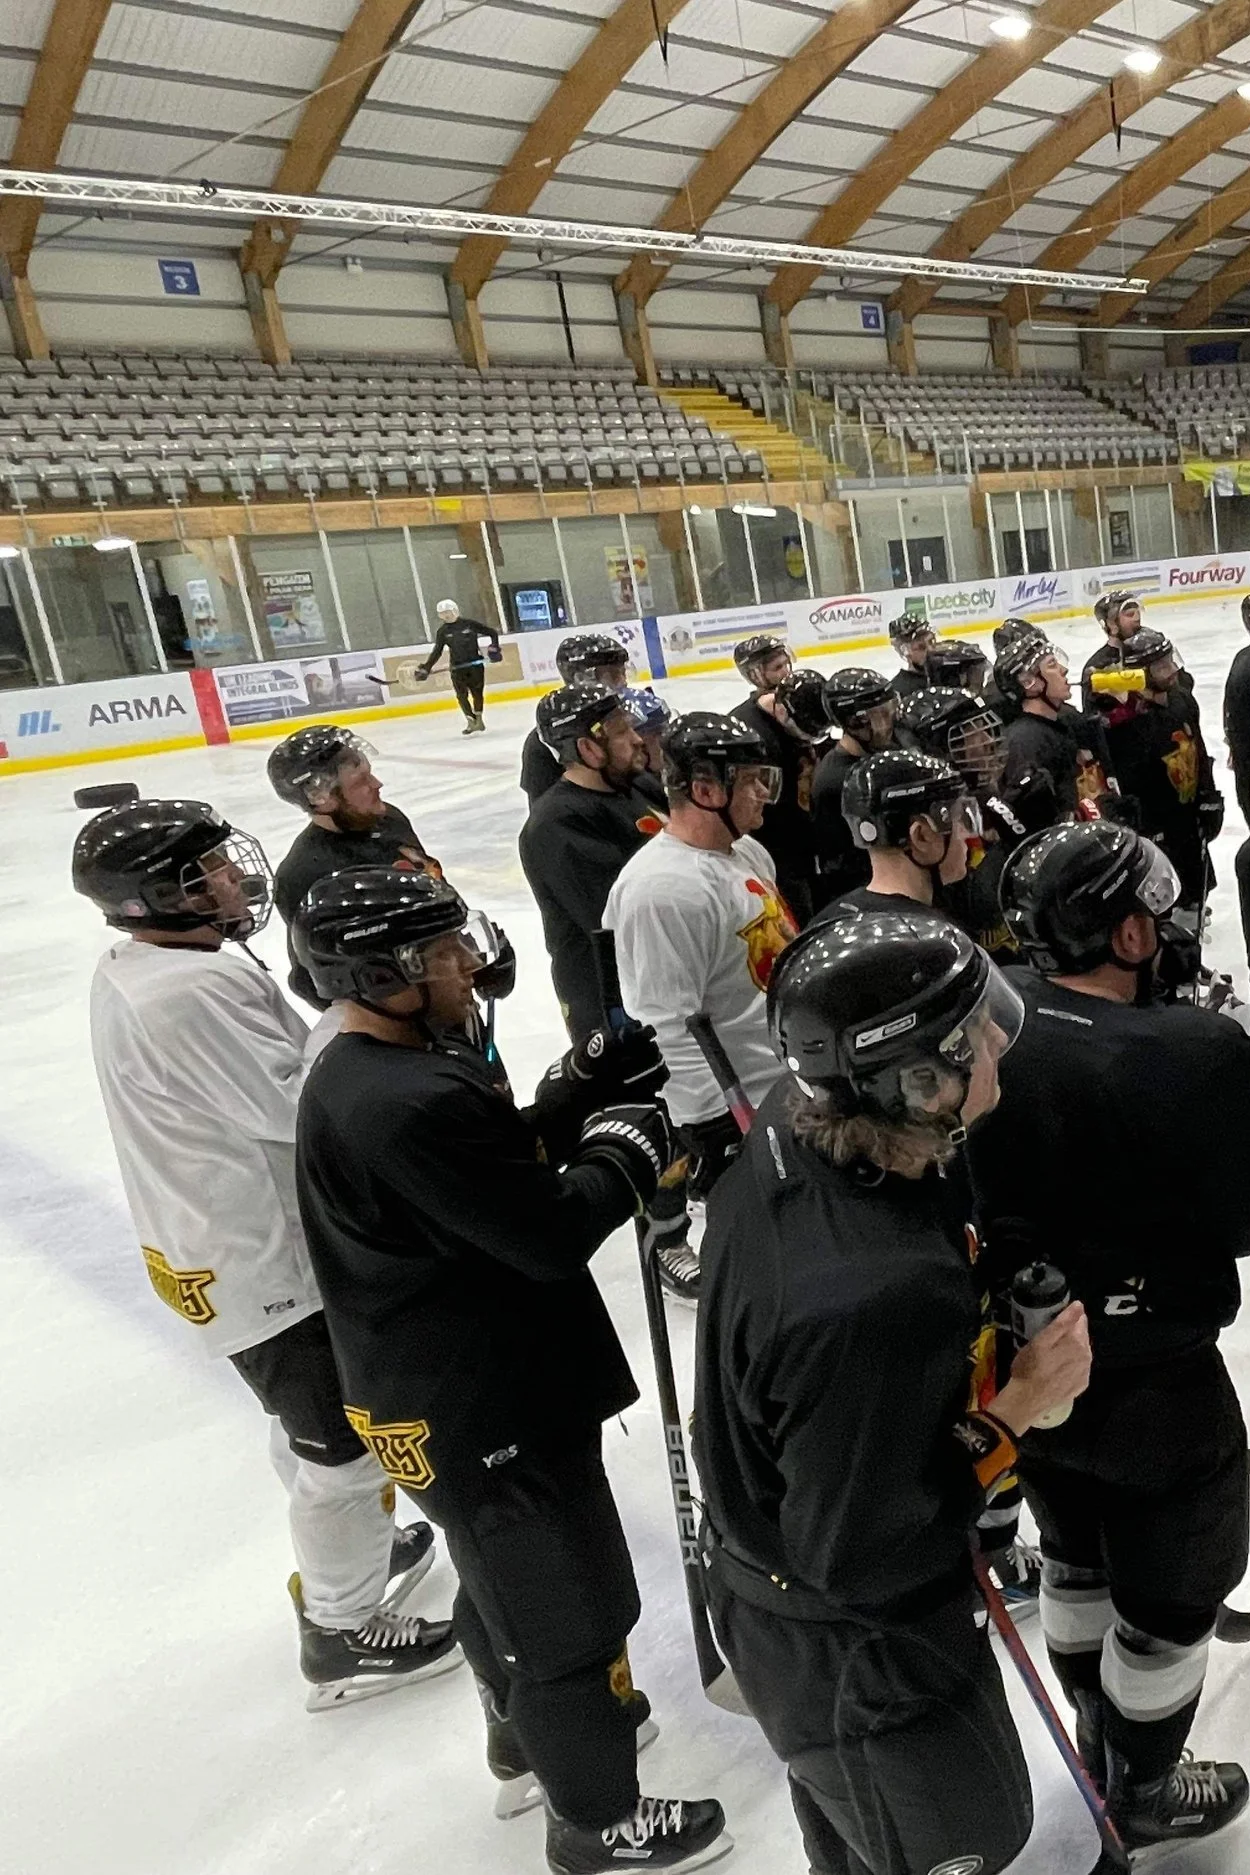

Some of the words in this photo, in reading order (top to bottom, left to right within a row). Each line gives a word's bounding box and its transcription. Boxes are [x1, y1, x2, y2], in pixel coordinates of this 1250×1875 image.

[174, 275, 188, 289] 3
[1169, 566, 1246, 587] Fourway
[809, 605, 882, 625] OKANAGAN
[88, 694, 187, 728] ARMA
